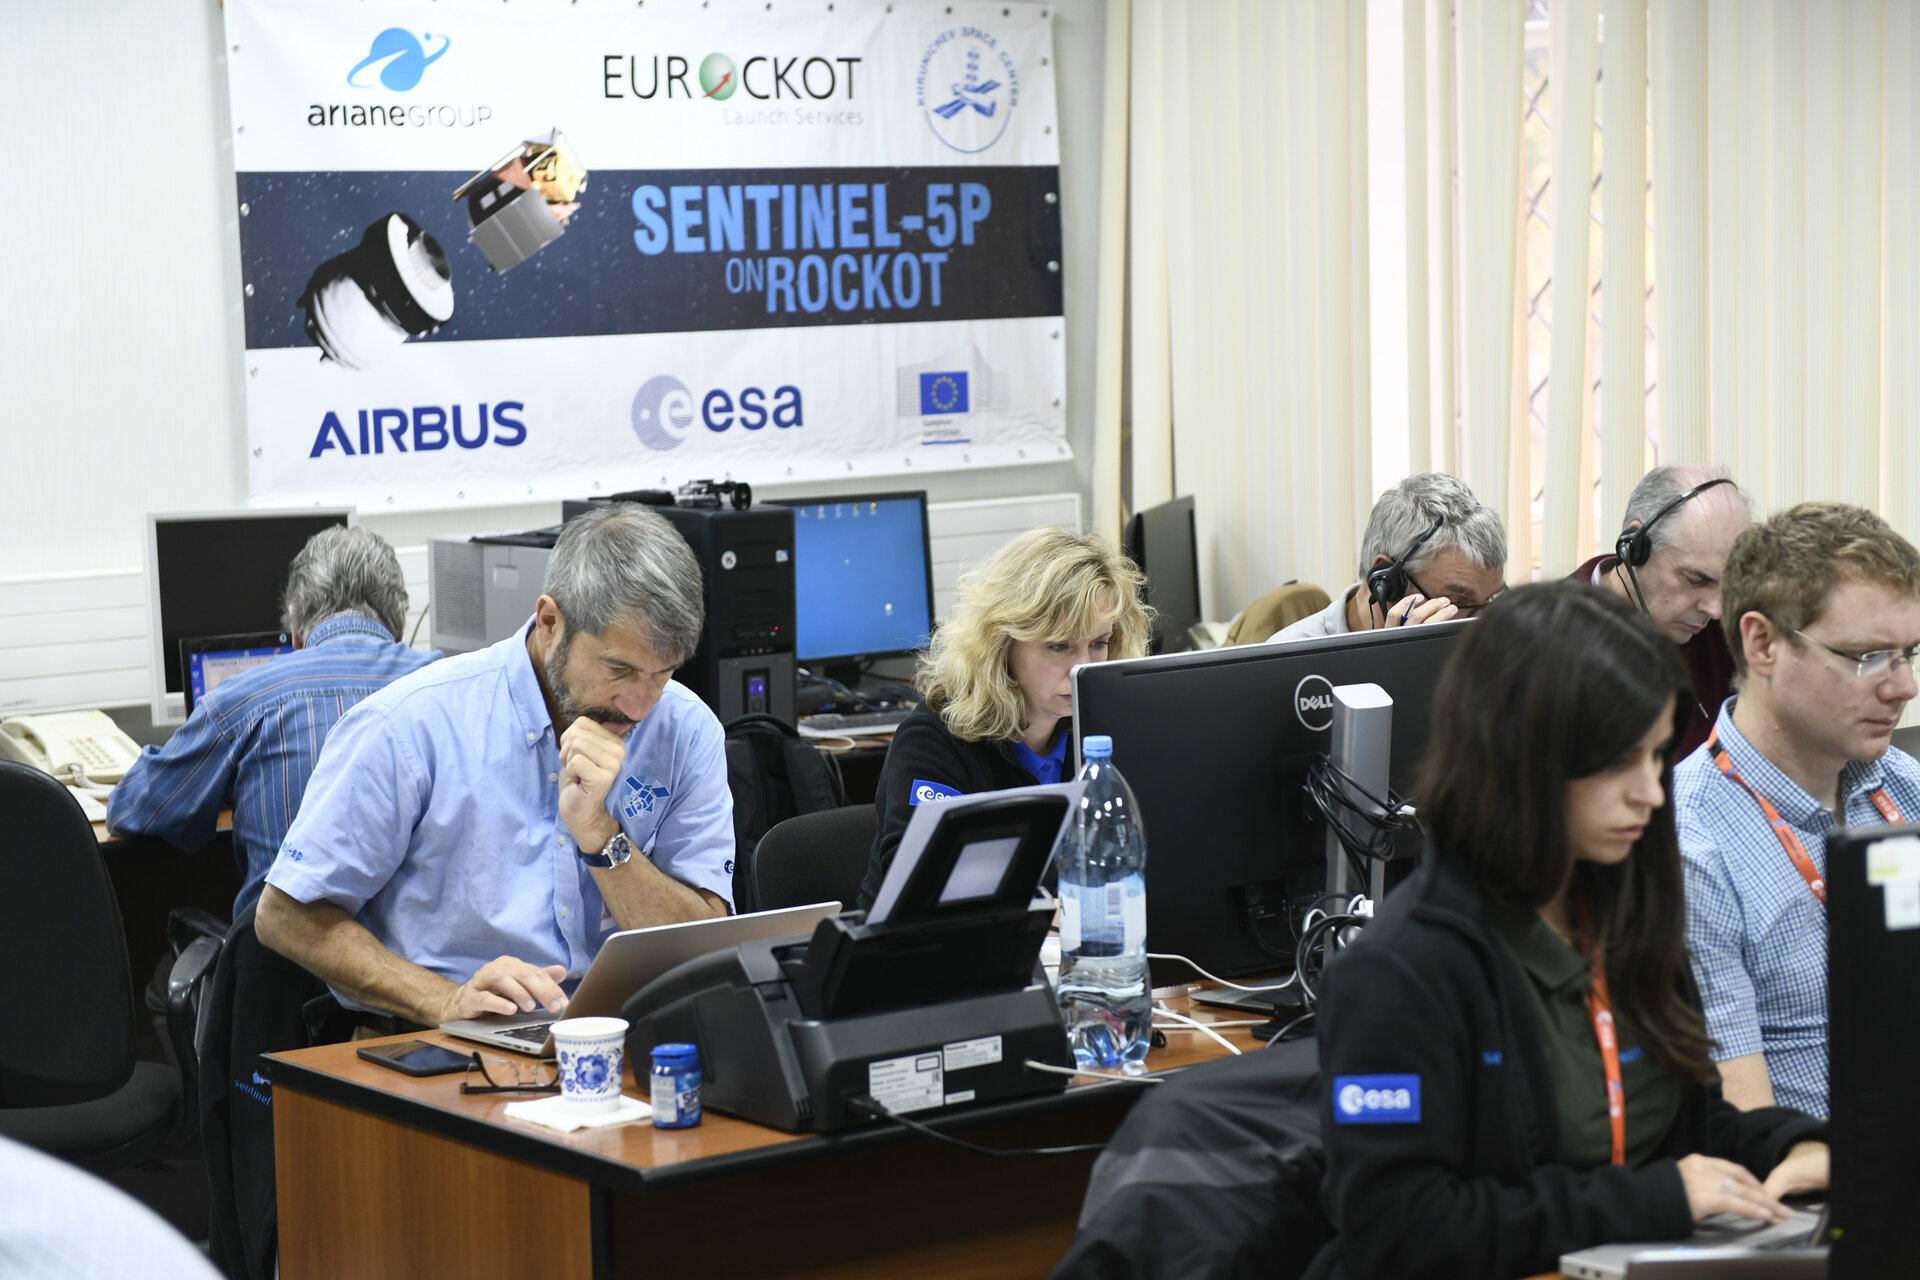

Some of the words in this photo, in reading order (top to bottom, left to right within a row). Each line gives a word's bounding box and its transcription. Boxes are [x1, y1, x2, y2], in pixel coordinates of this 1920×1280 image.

[960, 25, 997, 49] SPACE
[724, 107, 788, 125] Launch
[795, 107, 864, 126] Services
[631, 182, 992, 256] SENTINEL-5P
[725, 257, 764, 294] ON
[766, 252, 949, 314] ROCKOT
[309, 401, 527, 458] AIRBUS
[1299, 694, 1334, 711] DELL
